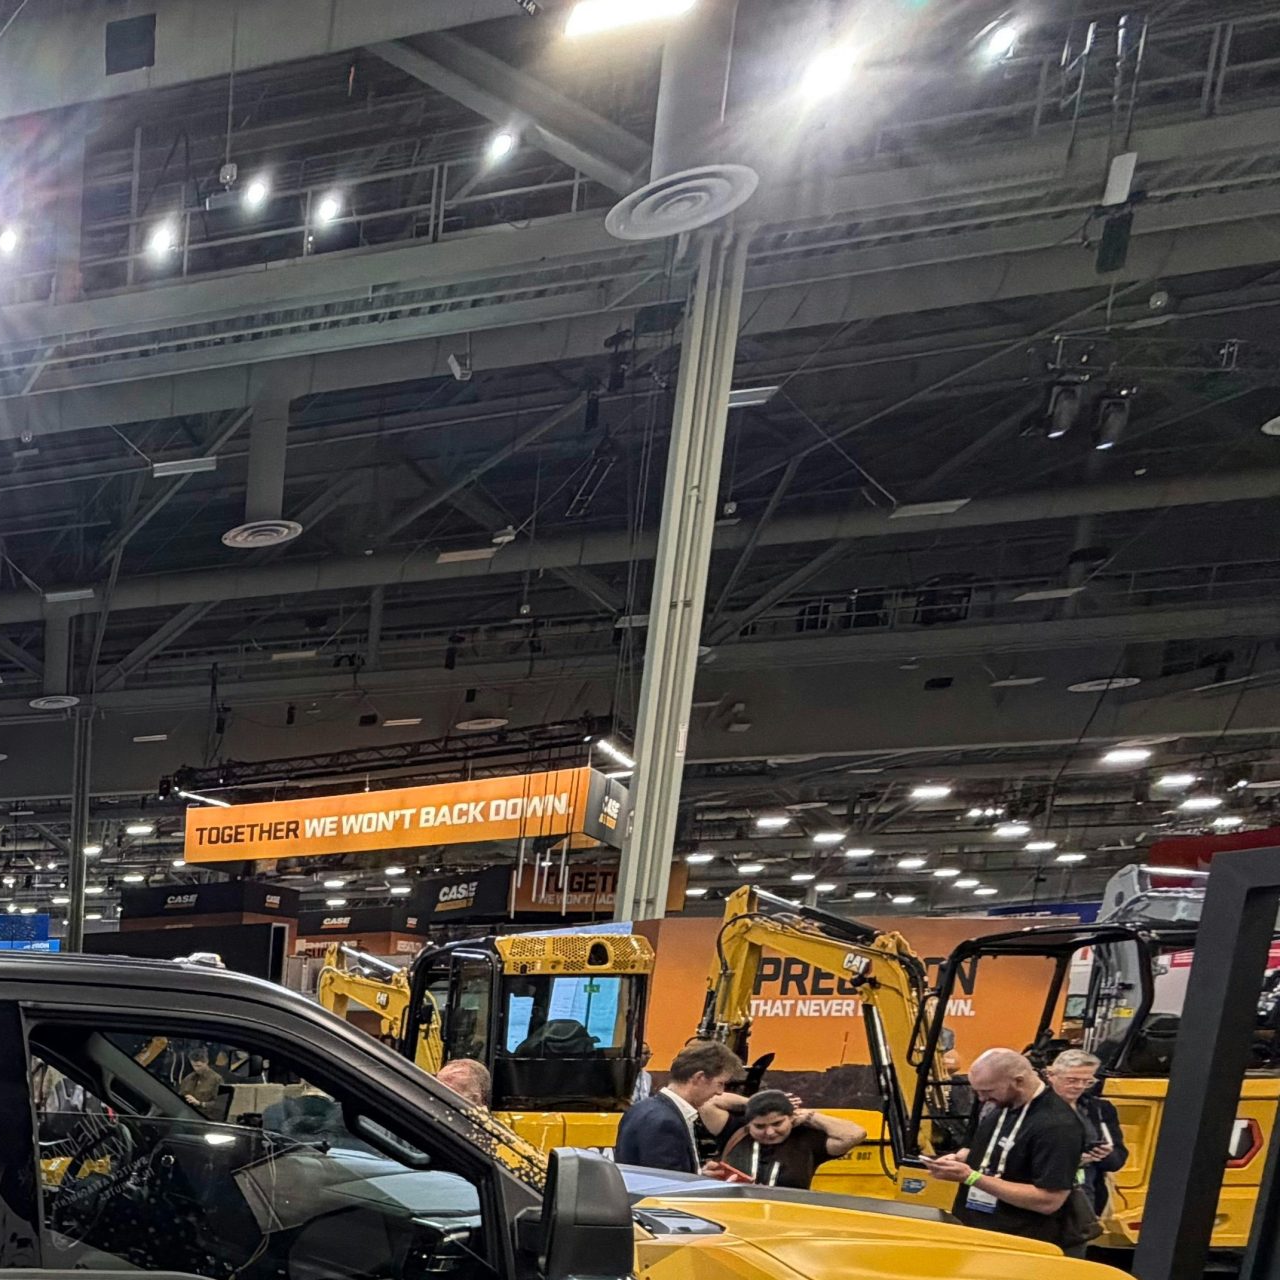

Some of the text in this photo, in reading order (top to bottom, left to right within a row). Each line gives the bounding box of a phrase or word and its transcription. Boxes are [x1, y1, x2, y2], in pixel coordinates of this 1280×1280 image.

[196, 792, 574, 845] TOGETHER WE WON'T BACK DOWN.
[167, 893, 198, 904] CASE
[439, 881, 478, 902] CASE
[322, 916, 352, 925] CASE
[843, 952, 870, 974] CAT
[750, 1000, 795, 1017] THAT
[795, 1000, 855, 1017] NEVER
